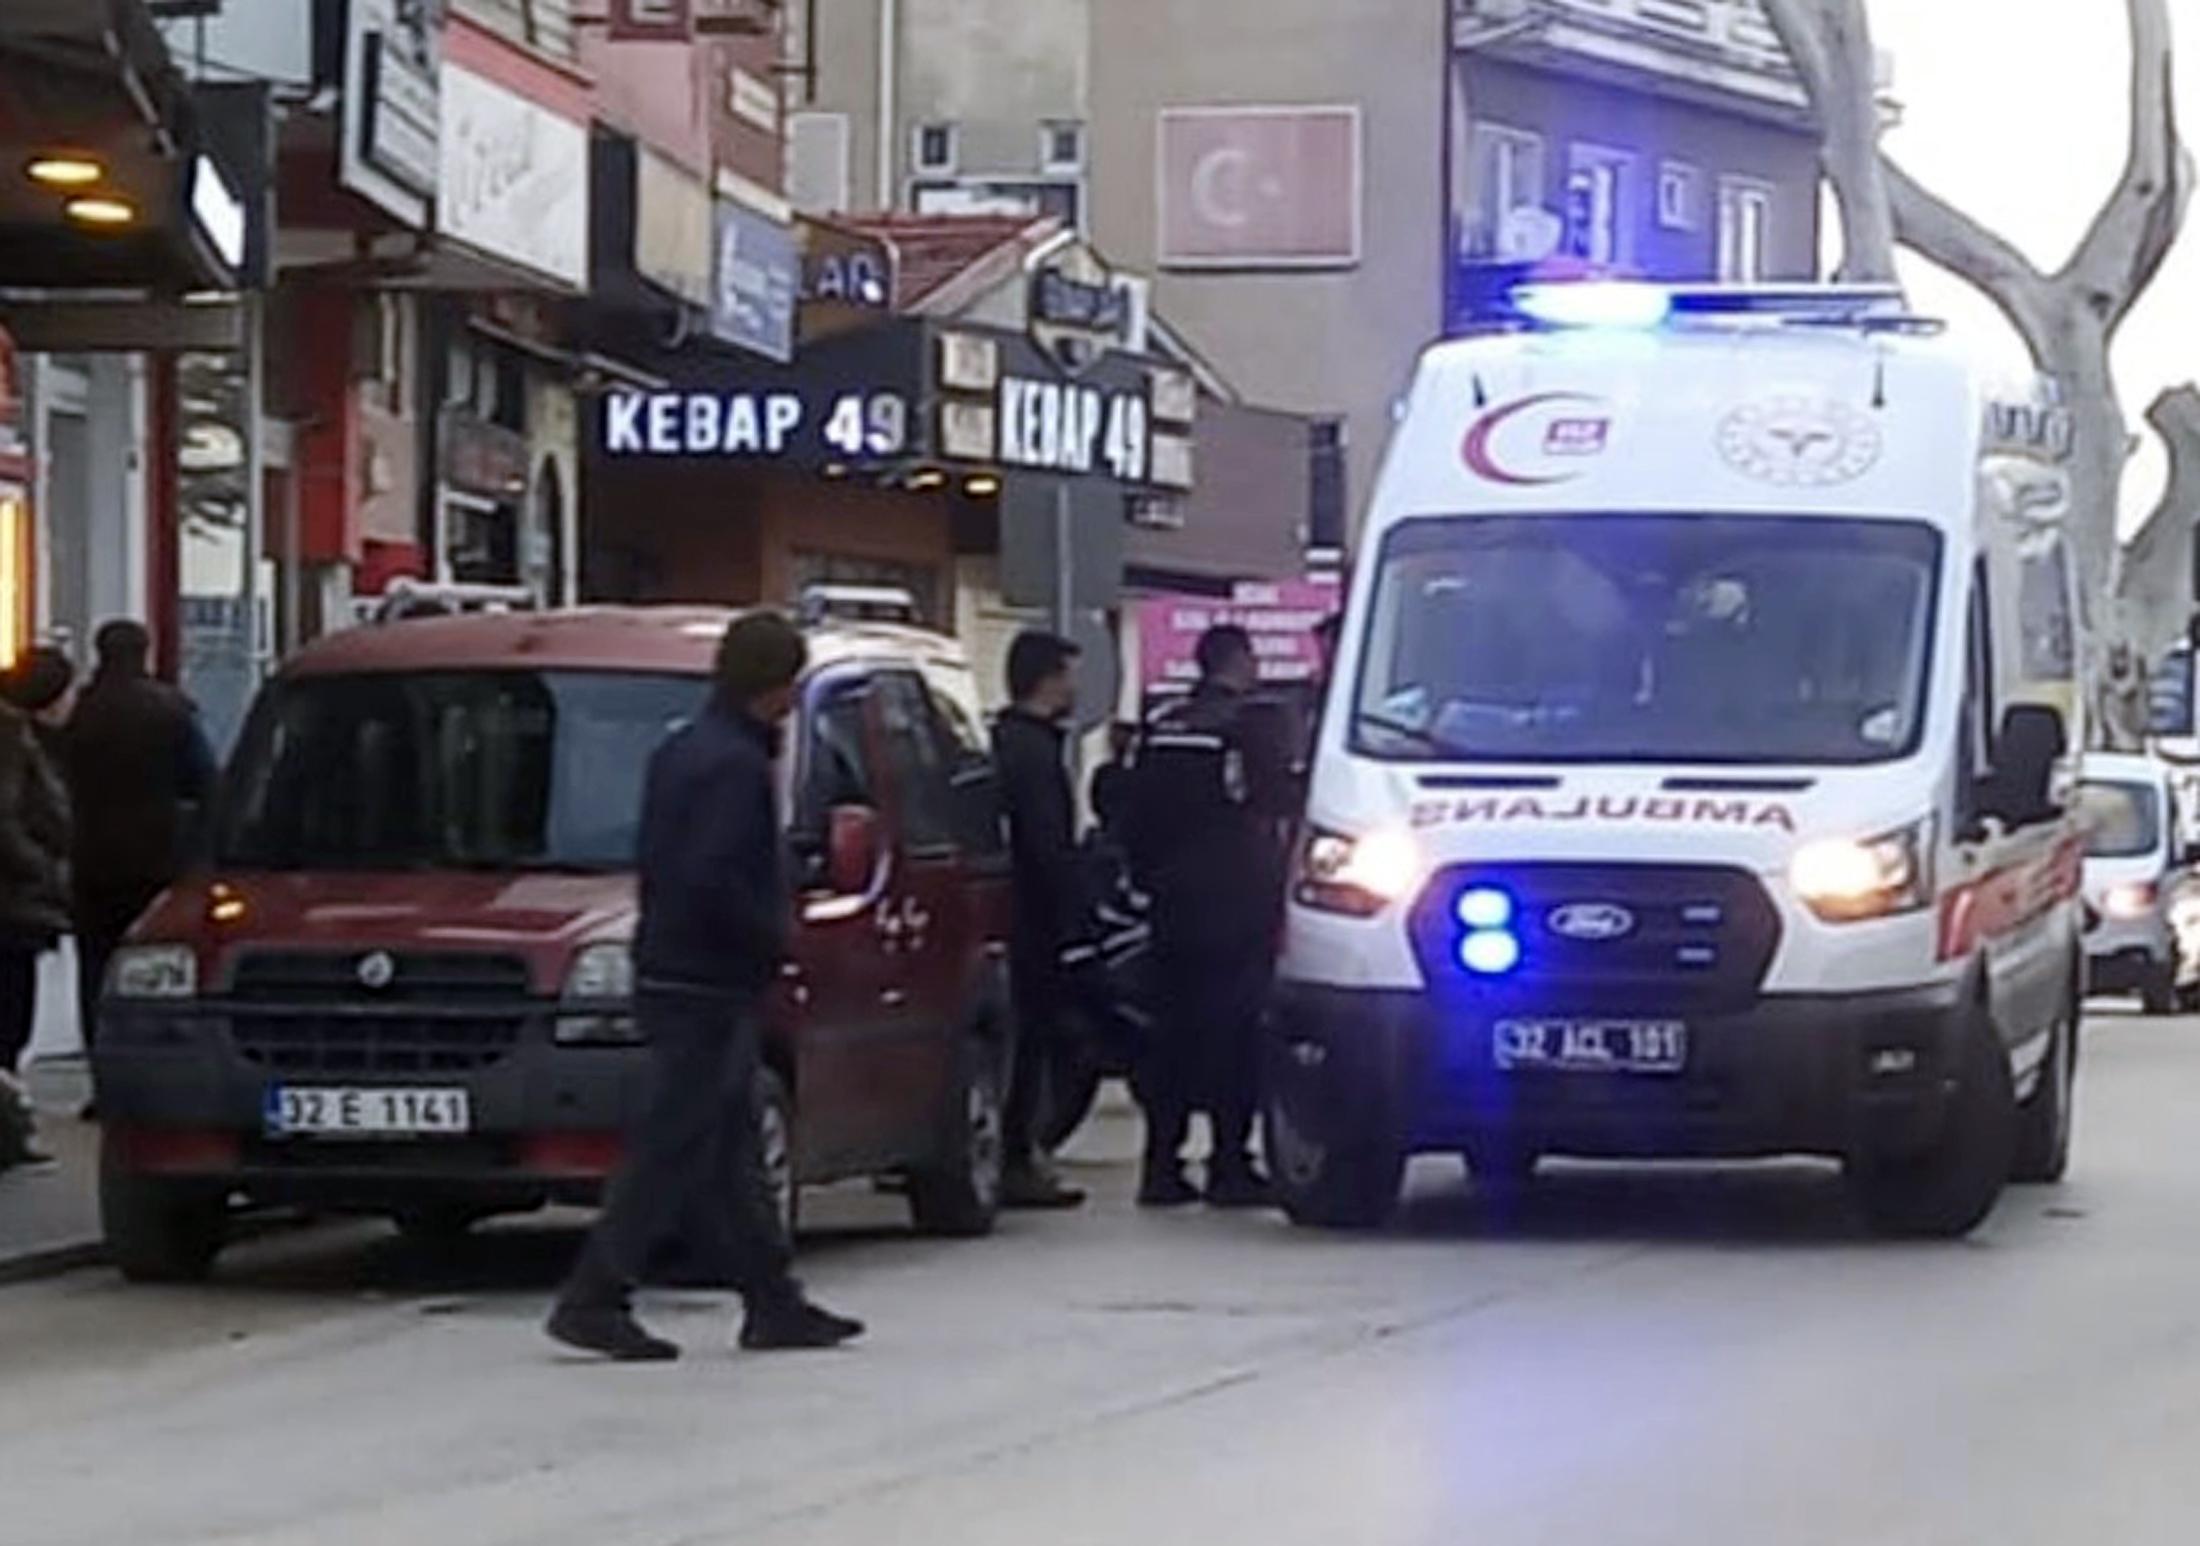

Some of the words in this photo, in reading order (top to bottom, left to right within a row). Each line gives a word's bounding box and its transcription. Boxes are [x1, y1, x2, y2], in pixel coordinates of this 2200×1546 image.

[607, 393, 801, 451] KEBAP
[825, 394, 905, 453] 49
[1001, 377, 1100, 472] KEBAP
[1104, 393, 1145, 479] 49
[288, 1093, 325, 1125] 32
[340, 1092, 361, 1126] E
[381, 1094, 460, 1124] 1141
